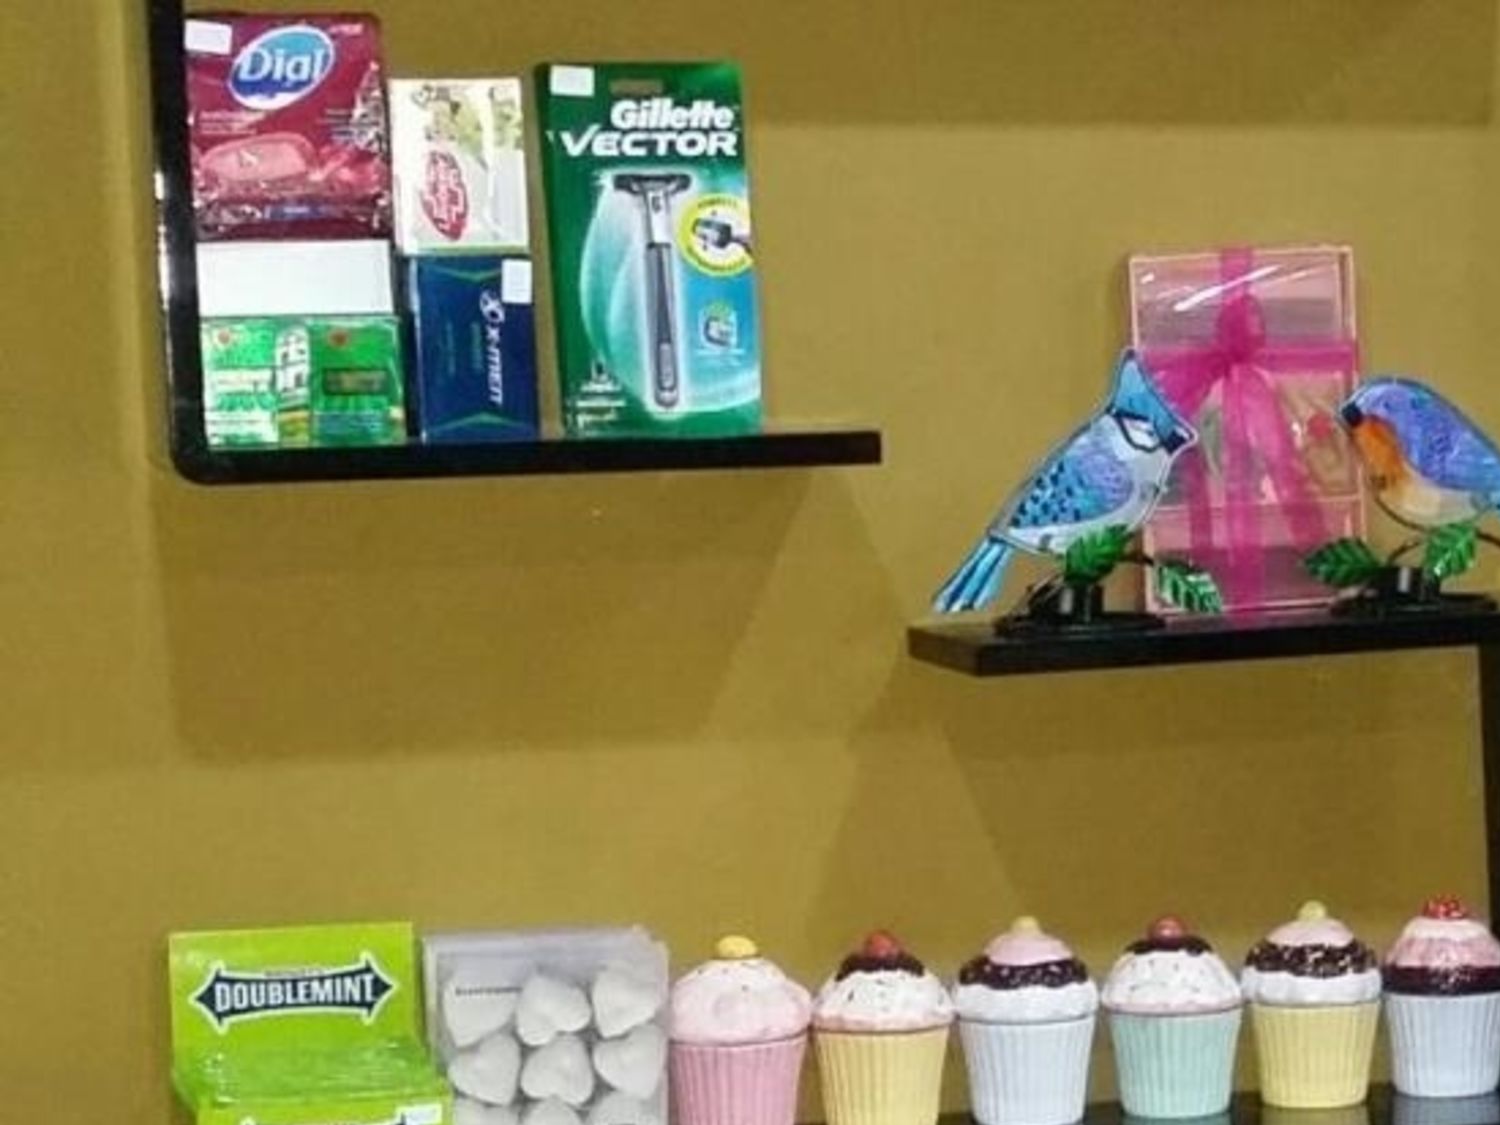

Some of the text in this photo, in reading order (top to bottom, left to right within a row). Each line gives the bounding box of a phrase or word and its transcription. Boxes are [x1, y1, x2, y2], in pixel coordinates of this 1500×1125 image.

[237, 48, 325, 84] Dial
[610, 97, 735, 130] Gillette
[559, 124, 738, 158] VECTOR
[214, 972, 375, 1014] DOUBLEMINT
